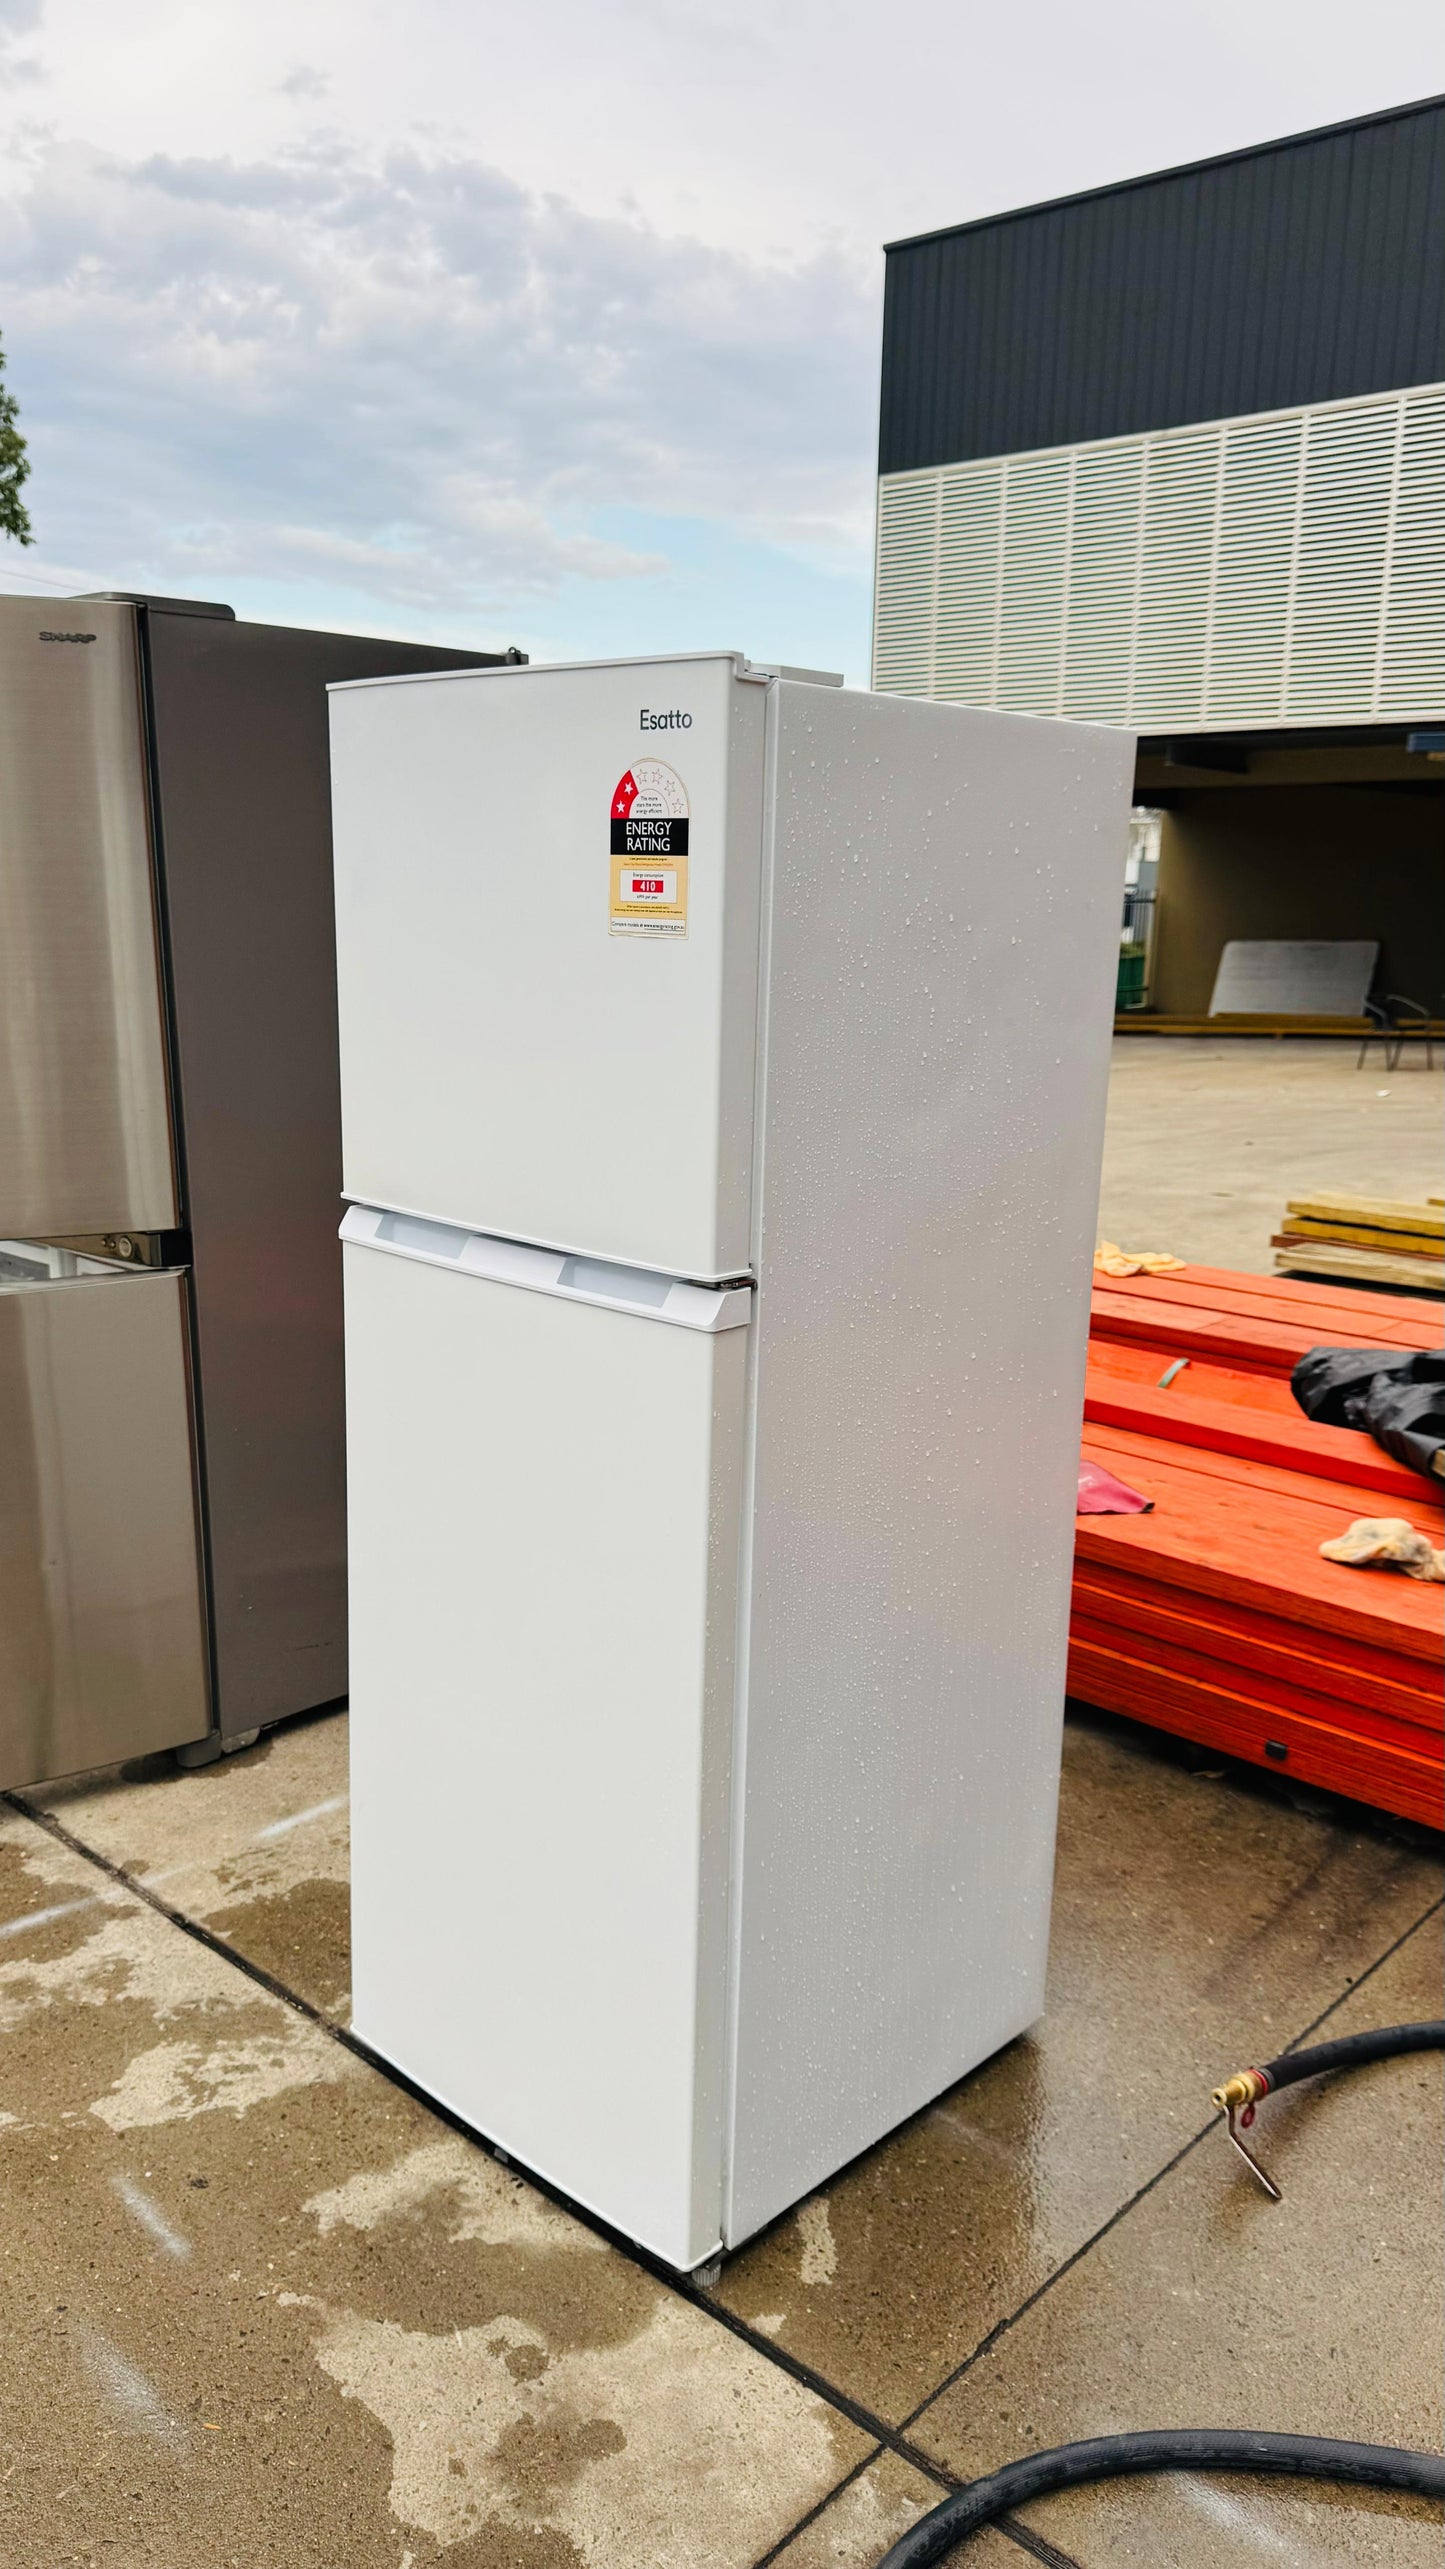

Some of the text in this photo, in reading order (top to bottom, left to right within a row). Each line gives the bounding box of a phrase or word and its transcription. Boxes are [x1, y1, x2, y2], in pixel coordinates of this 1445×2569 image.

[39, 631, 97, 644] SHARP
[640, 709, 692, 730] Esatto
[626, 821, 672, 836] ENERGY
[627, 837, 670, 852] RATING
[640, 881, 656, 892] 410
